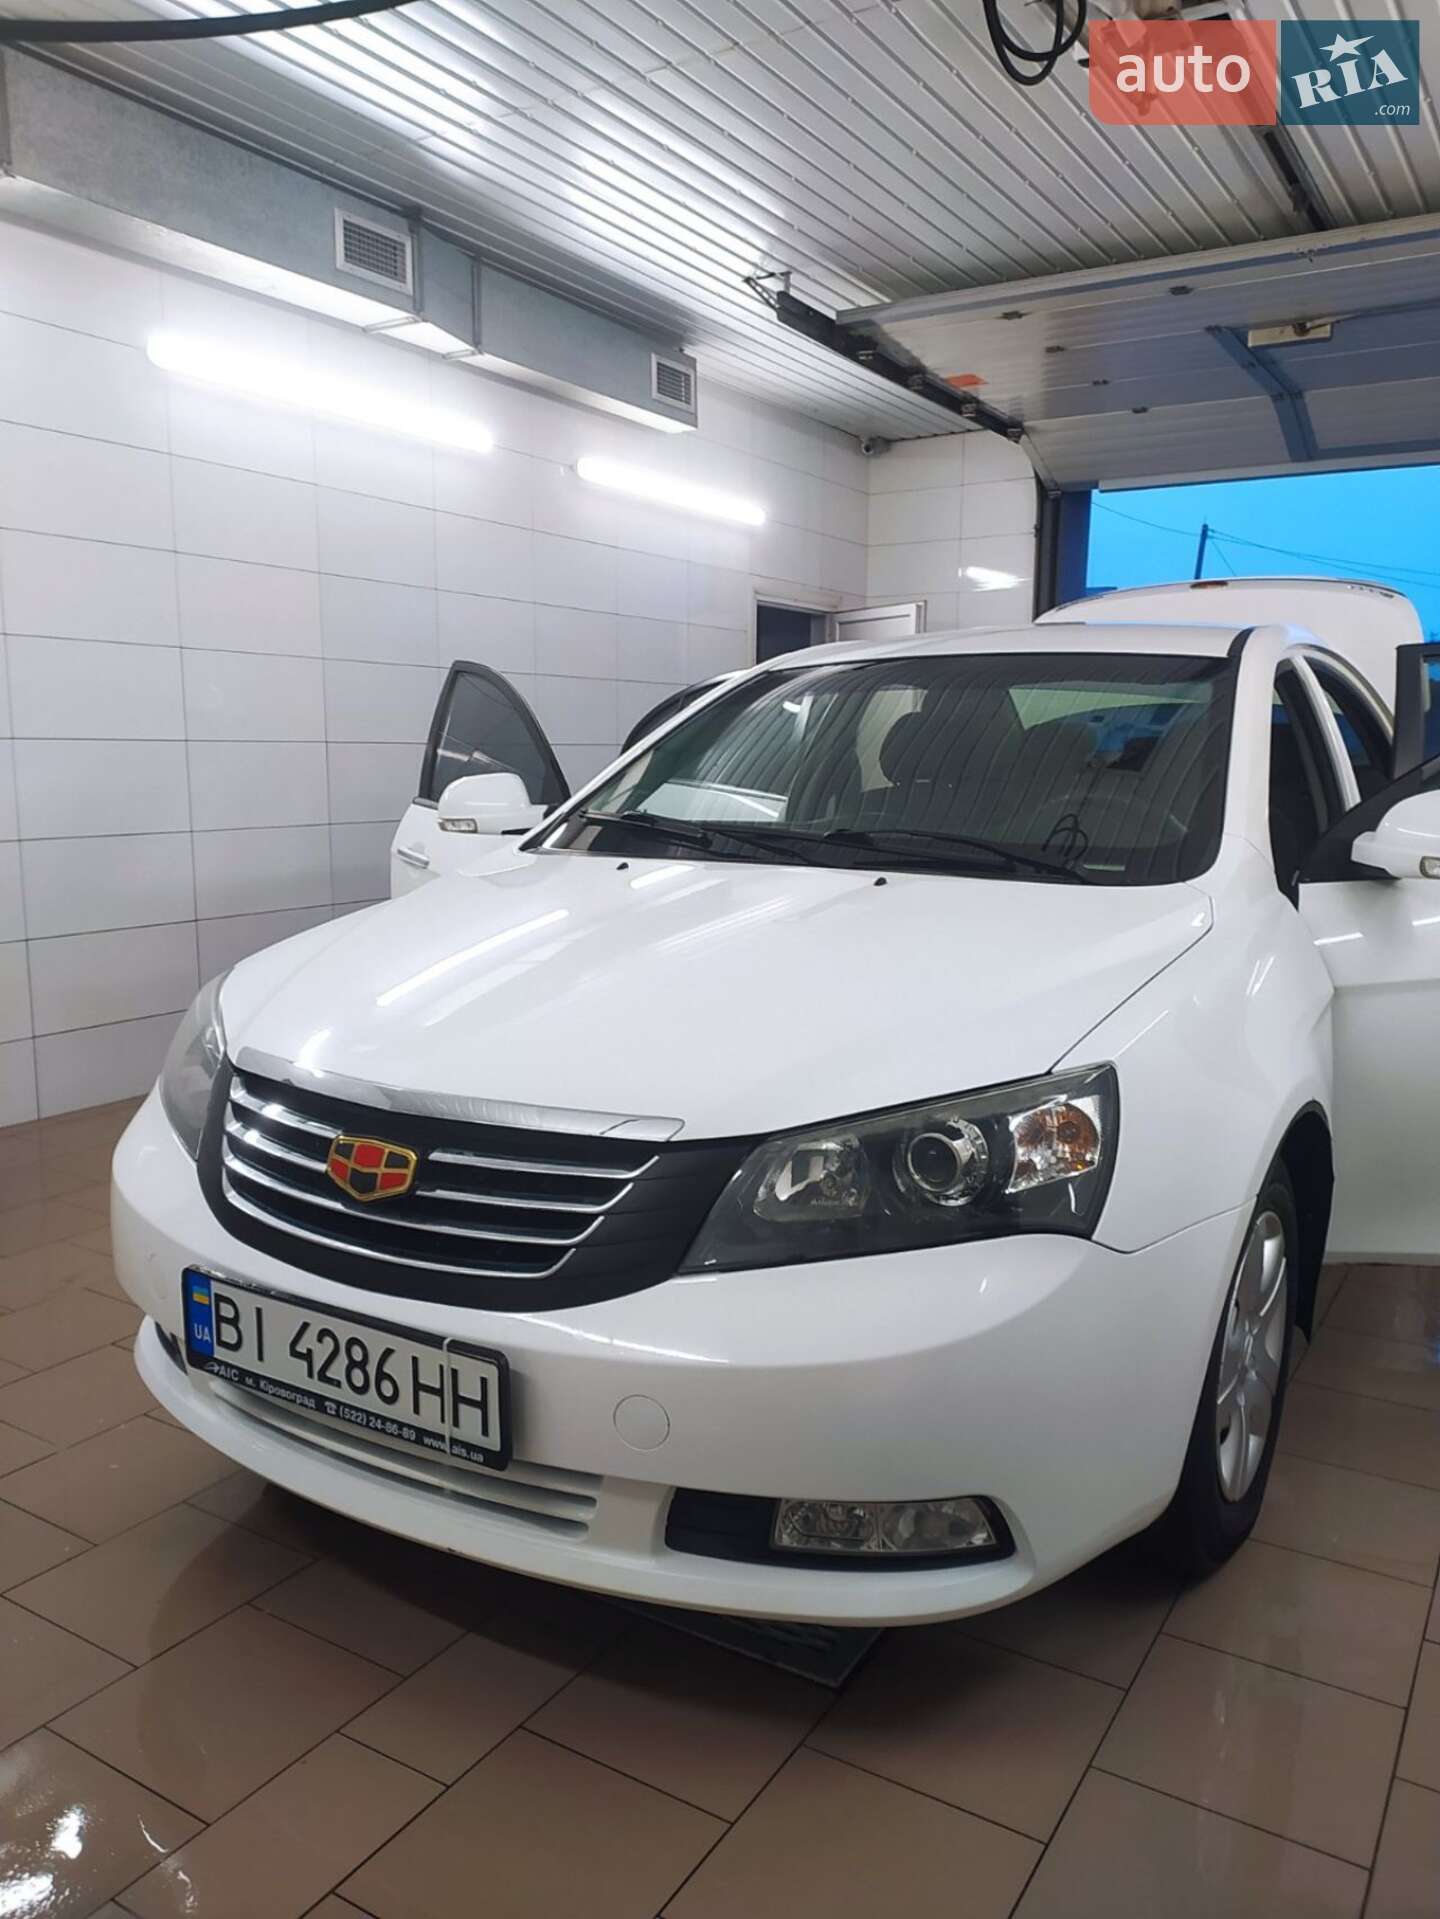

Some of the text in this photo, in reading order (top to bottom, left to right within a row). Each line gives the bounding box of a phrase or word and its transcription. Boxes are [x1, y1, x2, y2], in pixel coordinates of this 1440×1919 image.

[194, 1323, 212, 1344] UA
[339, 1405, 368, 1426] (522)
[423, 1435, 484, 1463] wwwais.ua
